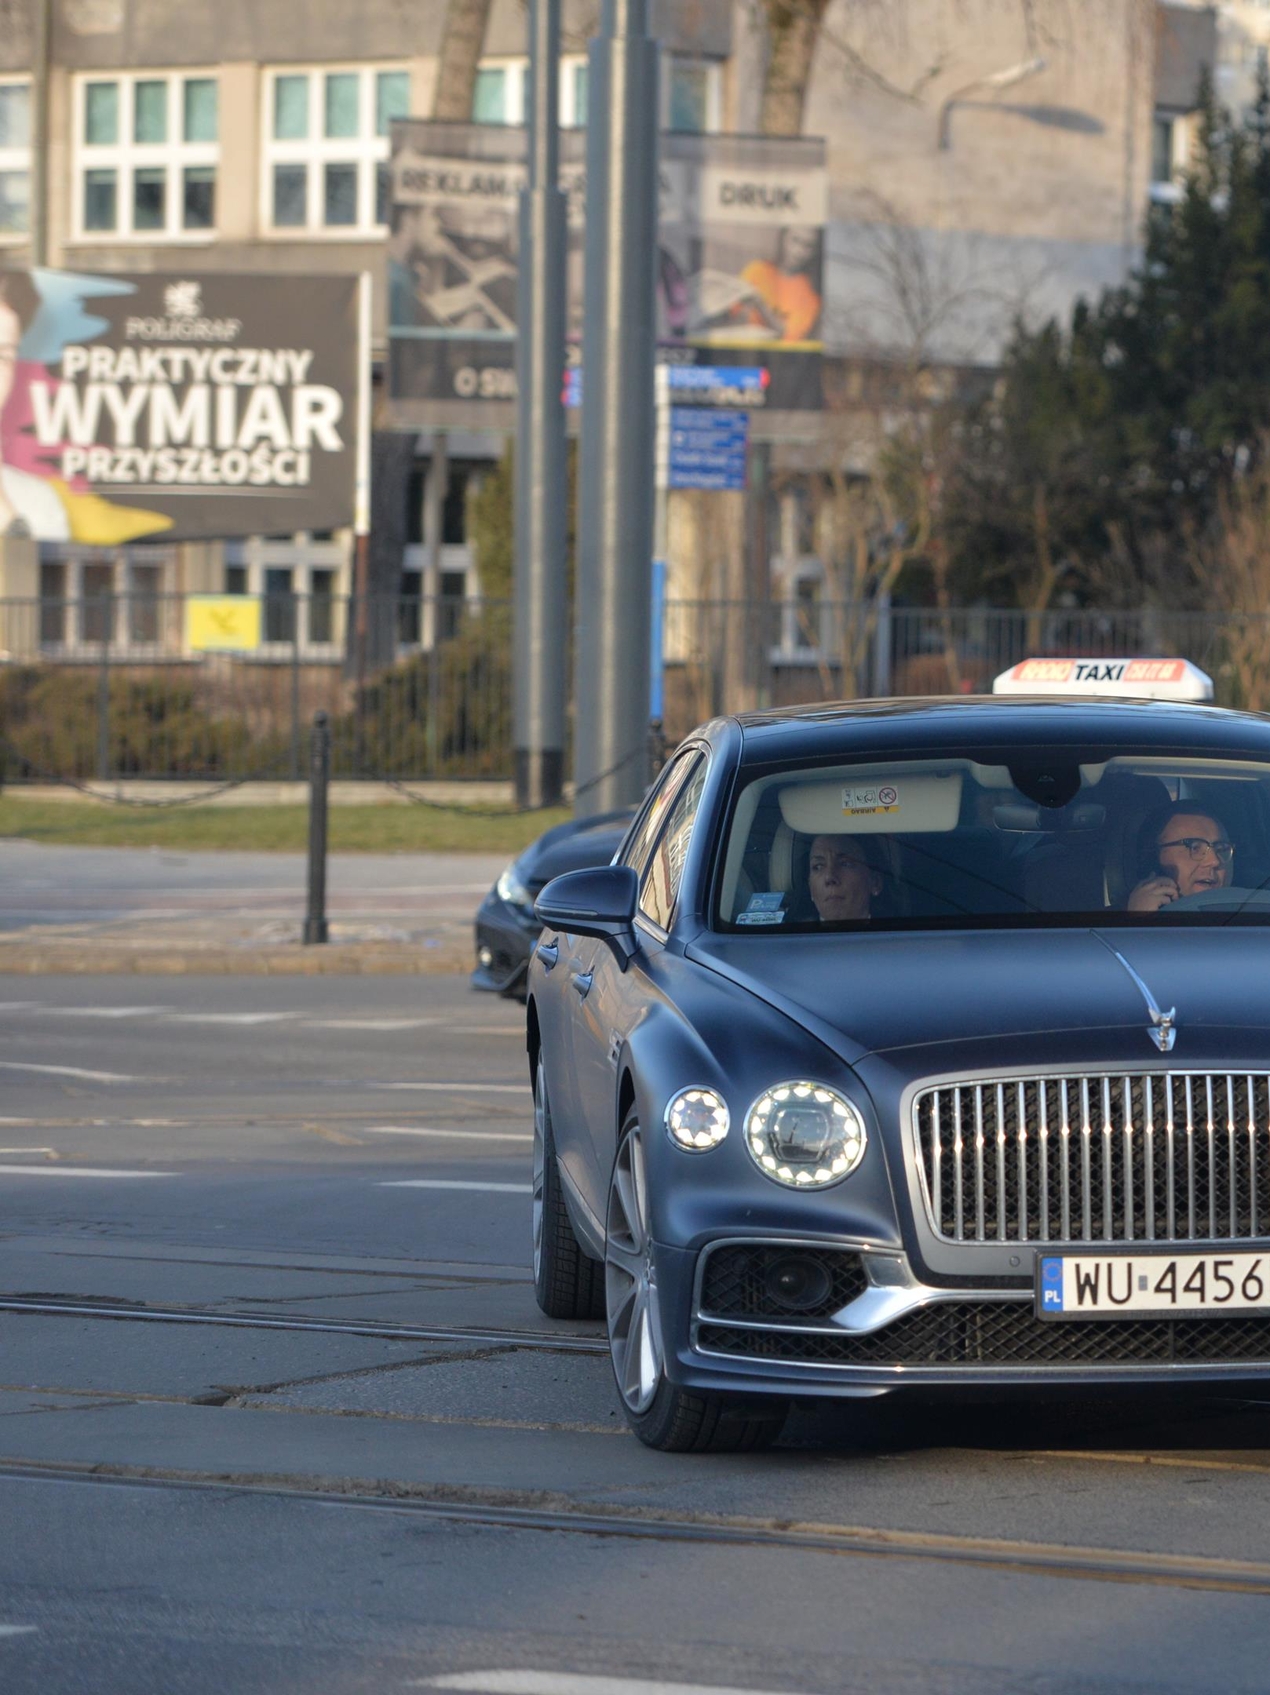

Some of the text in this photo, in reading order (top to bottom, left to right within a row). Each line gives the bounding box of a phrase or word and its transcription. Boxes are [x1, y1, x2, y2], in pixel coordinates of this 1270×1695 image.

[719, 182, 800, 212] DRUK
[126, 316, 242, 342] POLIGRAF
[63, 346, 313, 386] PRAKTYCZNY
[30, 381, 345, 452] WYMIAR
[63, 443, 310, 485] PRZYSZŁOŚCI
[1075, 664, 1125, 681] TAXI
[1045, 1290, 1061, 1303] PL
[1075, 1262, 1132, 1305] WU
